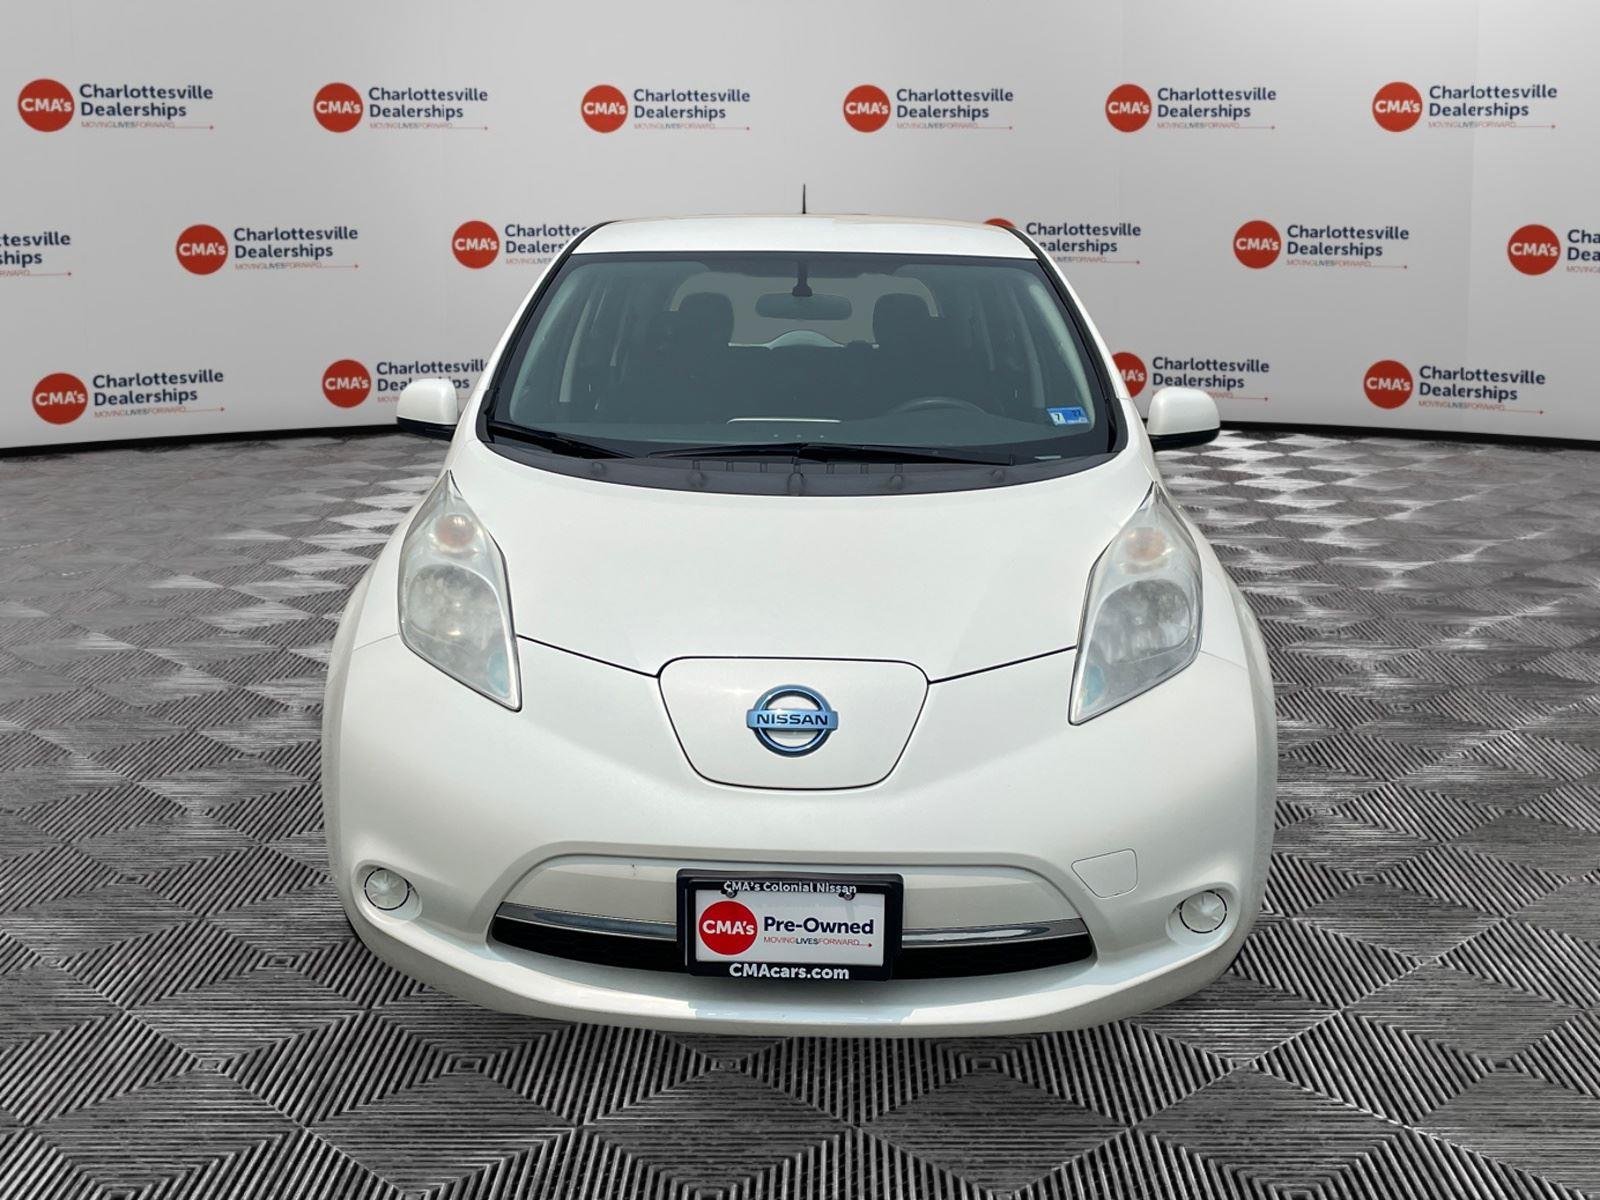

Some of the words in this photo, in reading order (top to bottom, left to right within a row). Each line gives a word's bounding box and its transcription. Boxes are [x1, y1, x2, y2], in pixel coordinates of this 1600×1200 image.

[79, 84, 213, 99] Charlottesville
[368, 87, 488, 101] Charlottesville
[634, 89, 750, 102] Charlottesville
[897, 89, 1013, 102] Charlottesville
[1158, 87, 1276, 101] Charlottesville
[1430, 84, 1557, 99] Charlottesville
[20, 97, 73, 113] CMA's
[81, 102, 186, 120] Dealerships
[315, 100, 362, 115] CMA's
[370, 104, 463, 121] Dealerships
[583, 101, 627, 116] CMA's
[845, 101, 889, 115] CMA's
[1108, 100, 1150, 115] CMA's
[1158, 104, 1250, 121] Dealerships
[1374, 99, 1421, 114] CMA's
[1429, 102, 1529, 120] Dealerships
[635, 105, 726, 122] Dealerships
[897, 105, 989, 121] Dealerships
[234, 226, 358, 241] Charlottesville
[1026, 222, 1141, 236] Charlottesville
[1287, 225, 1409, 242] Charlottesville
[0, 231, 70, 247] tesville
[454, 237, 498, 251] CMA's
[1237, 239, 1278, 250] CMA's
[180, 243, 225, 255] CMA's
[235, 244, 333, 260] Dealerships
[1040, 239, 1118, 255] ealerships
[1288, 241, 1382, 259] Dealerships
[1511, 243, 1557, 256] CMA's
[376, 359, 487, 375] Charlottesvill
[1153, 357, 1269, 372] Charlottesville
[93, 369, 223, 389] Charlottesville
[324, 376, 370, 390] CMA's
[1153, 373, 1244, 391] Dealerships
[1419, 366, 1545, 385] Charlottesville
[1367, 378, 1409, 390] CMA's
[36, 392, 84, 405] CMA's
[94, 388, 197, 406] Dealerships
[1419, 382, 1517, 404] Dealerships
[757, 713, 828, 725] NISSAN
[723, 880, 761, 892] CMA's
[763, 881, 814, 893] Colonial
[816, 882, 857, 894] Nissan
[702, 919, 755, 936] CMA's
[763, 916, 875, 935] Pre-Owned
[729, 963, 850, 980] CMAcars.com
